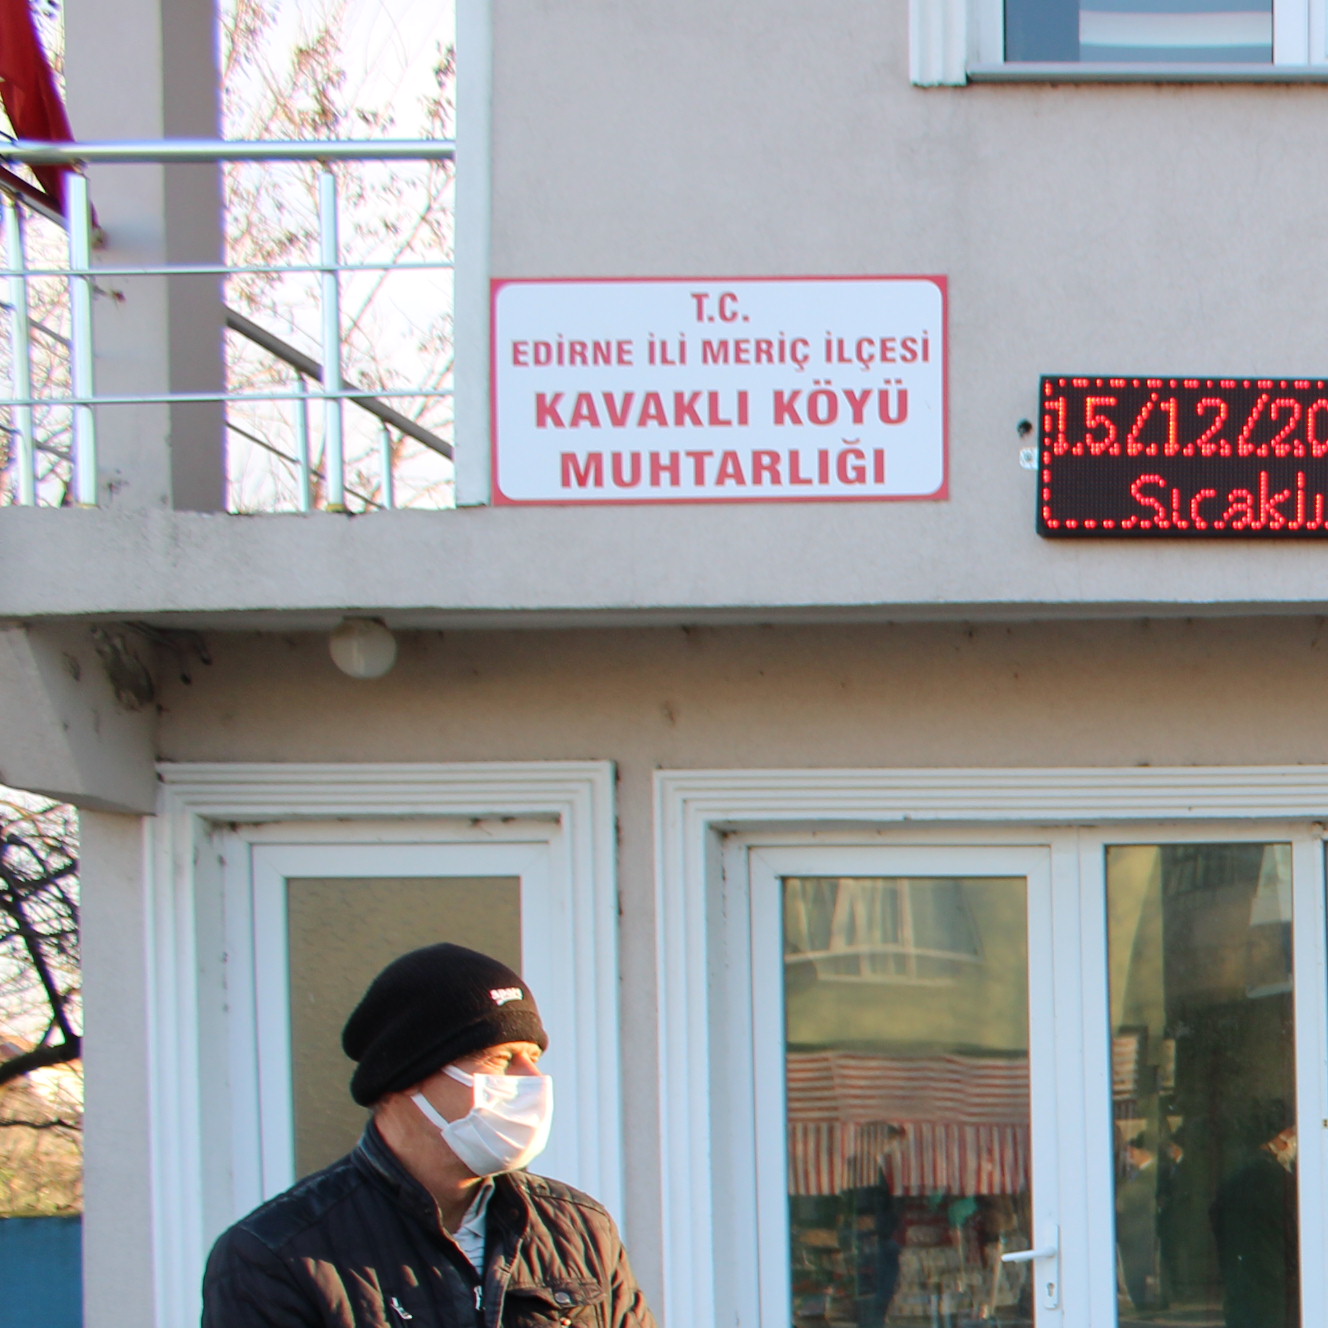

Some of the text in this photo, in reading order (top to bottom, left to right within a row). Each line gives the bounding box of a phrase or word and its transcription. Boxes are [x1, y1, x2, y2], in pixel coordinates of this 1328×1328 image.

[691, 291, 750, 322] T.C.
[511, 330, 930, 372] EDİRNE İLİ MERİÇ İLÇESİ
[534, 379, 909, 429] KAVAKLI KÖYÜ
[560, 437, 886, 489] MUHTARLIĞI
